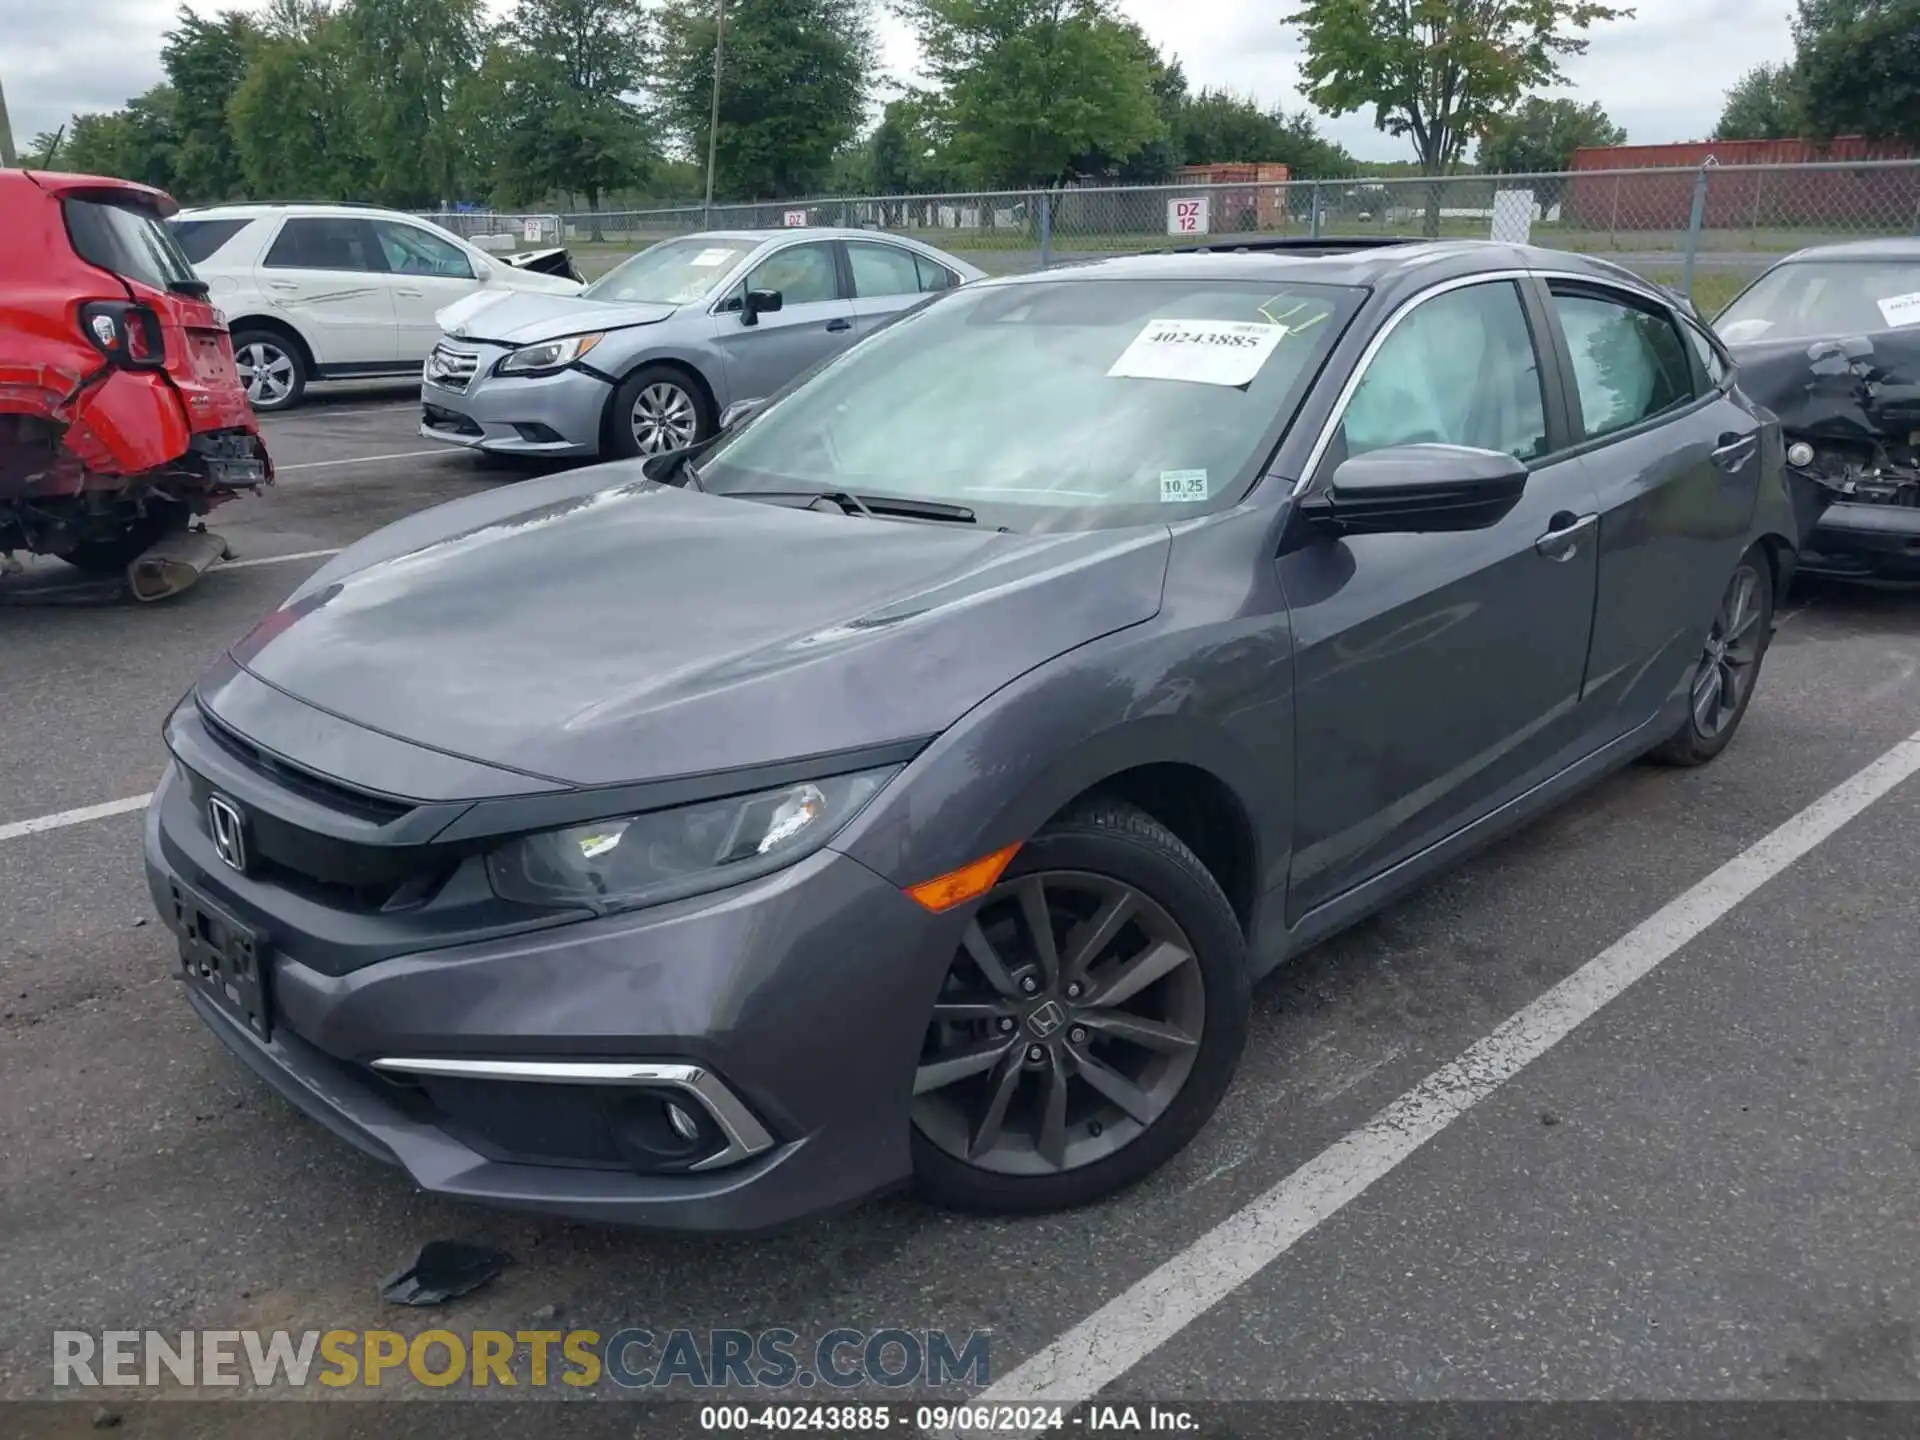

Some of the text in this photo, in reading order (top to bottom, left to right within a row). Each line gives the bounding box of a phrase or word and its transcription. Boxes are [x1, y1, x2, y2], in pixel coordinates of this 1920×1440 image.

[1177, 202, 1200, 217] DZ
[1179, 217, 1196, 230] 12
[1150, 331, 1260, 348] 40243885
[1164, 479, 1204, 493] 10 25
